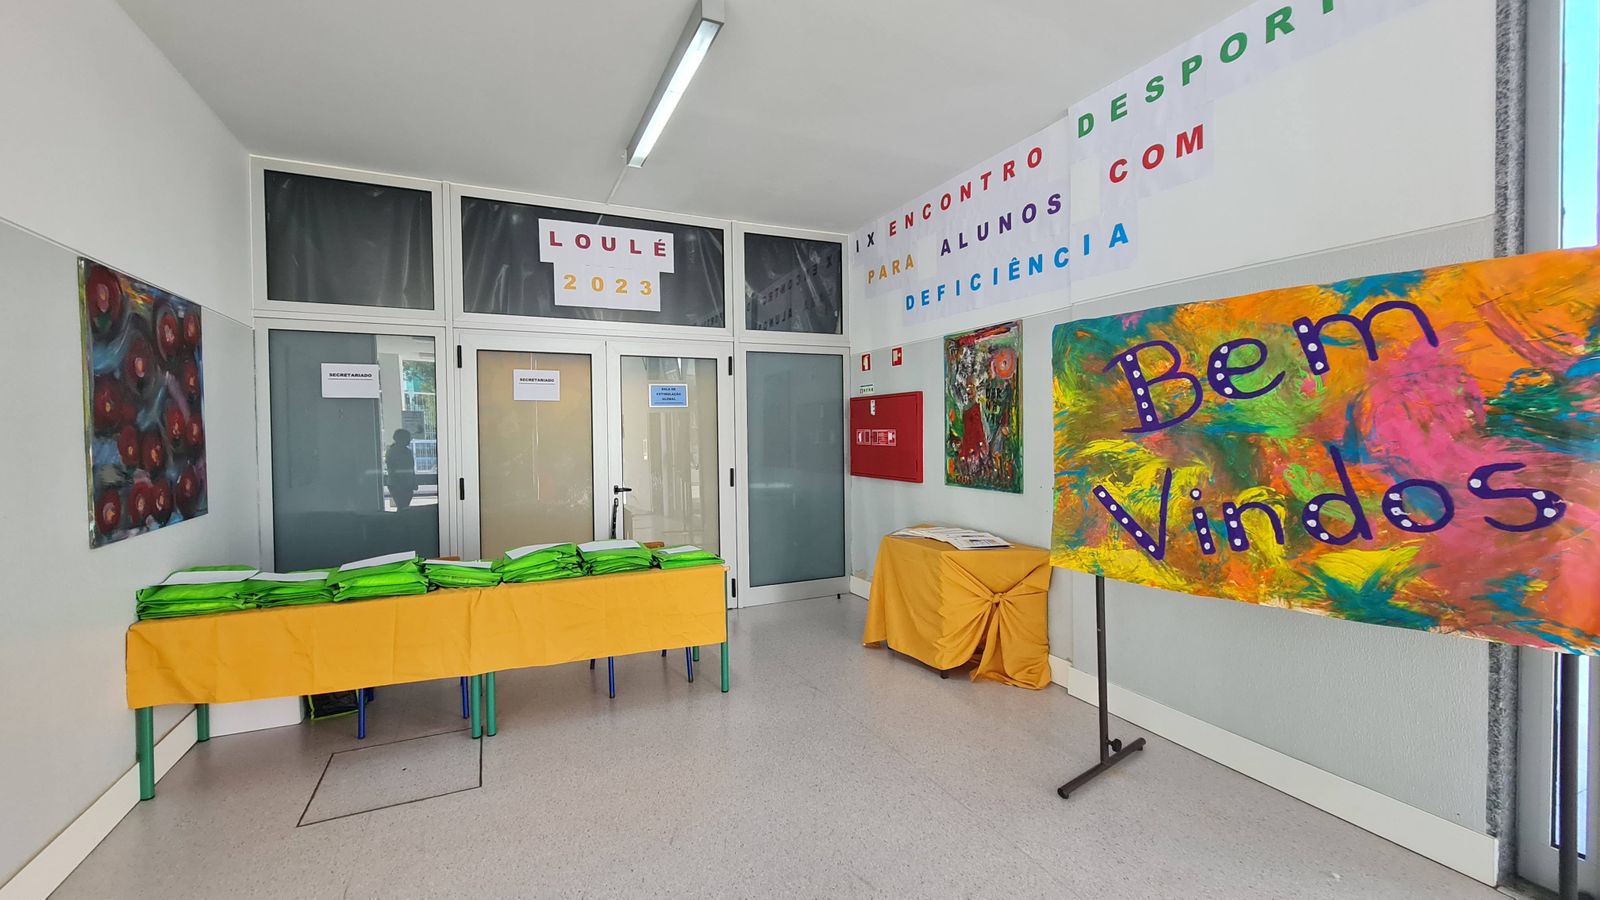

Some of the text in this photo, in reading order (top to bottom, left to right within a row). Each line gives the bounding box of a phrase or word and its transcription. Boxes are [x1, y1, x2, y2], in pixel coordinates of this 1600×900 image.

[549, 231, 664, 257] LOULÉ
[855, 231, 875, 254] IX
[888, 146, 1043, 238] ENCONTRO
[867, 124, 1205, 284] PARA ALUNOS COM
[563, 273, 653, 296] 2023
[905, 221, 1130, 311] DEFICIÊNCIA
[1101, 300, 1439, 434] Bem
[1093, 445, 1567, 561] Vindos
